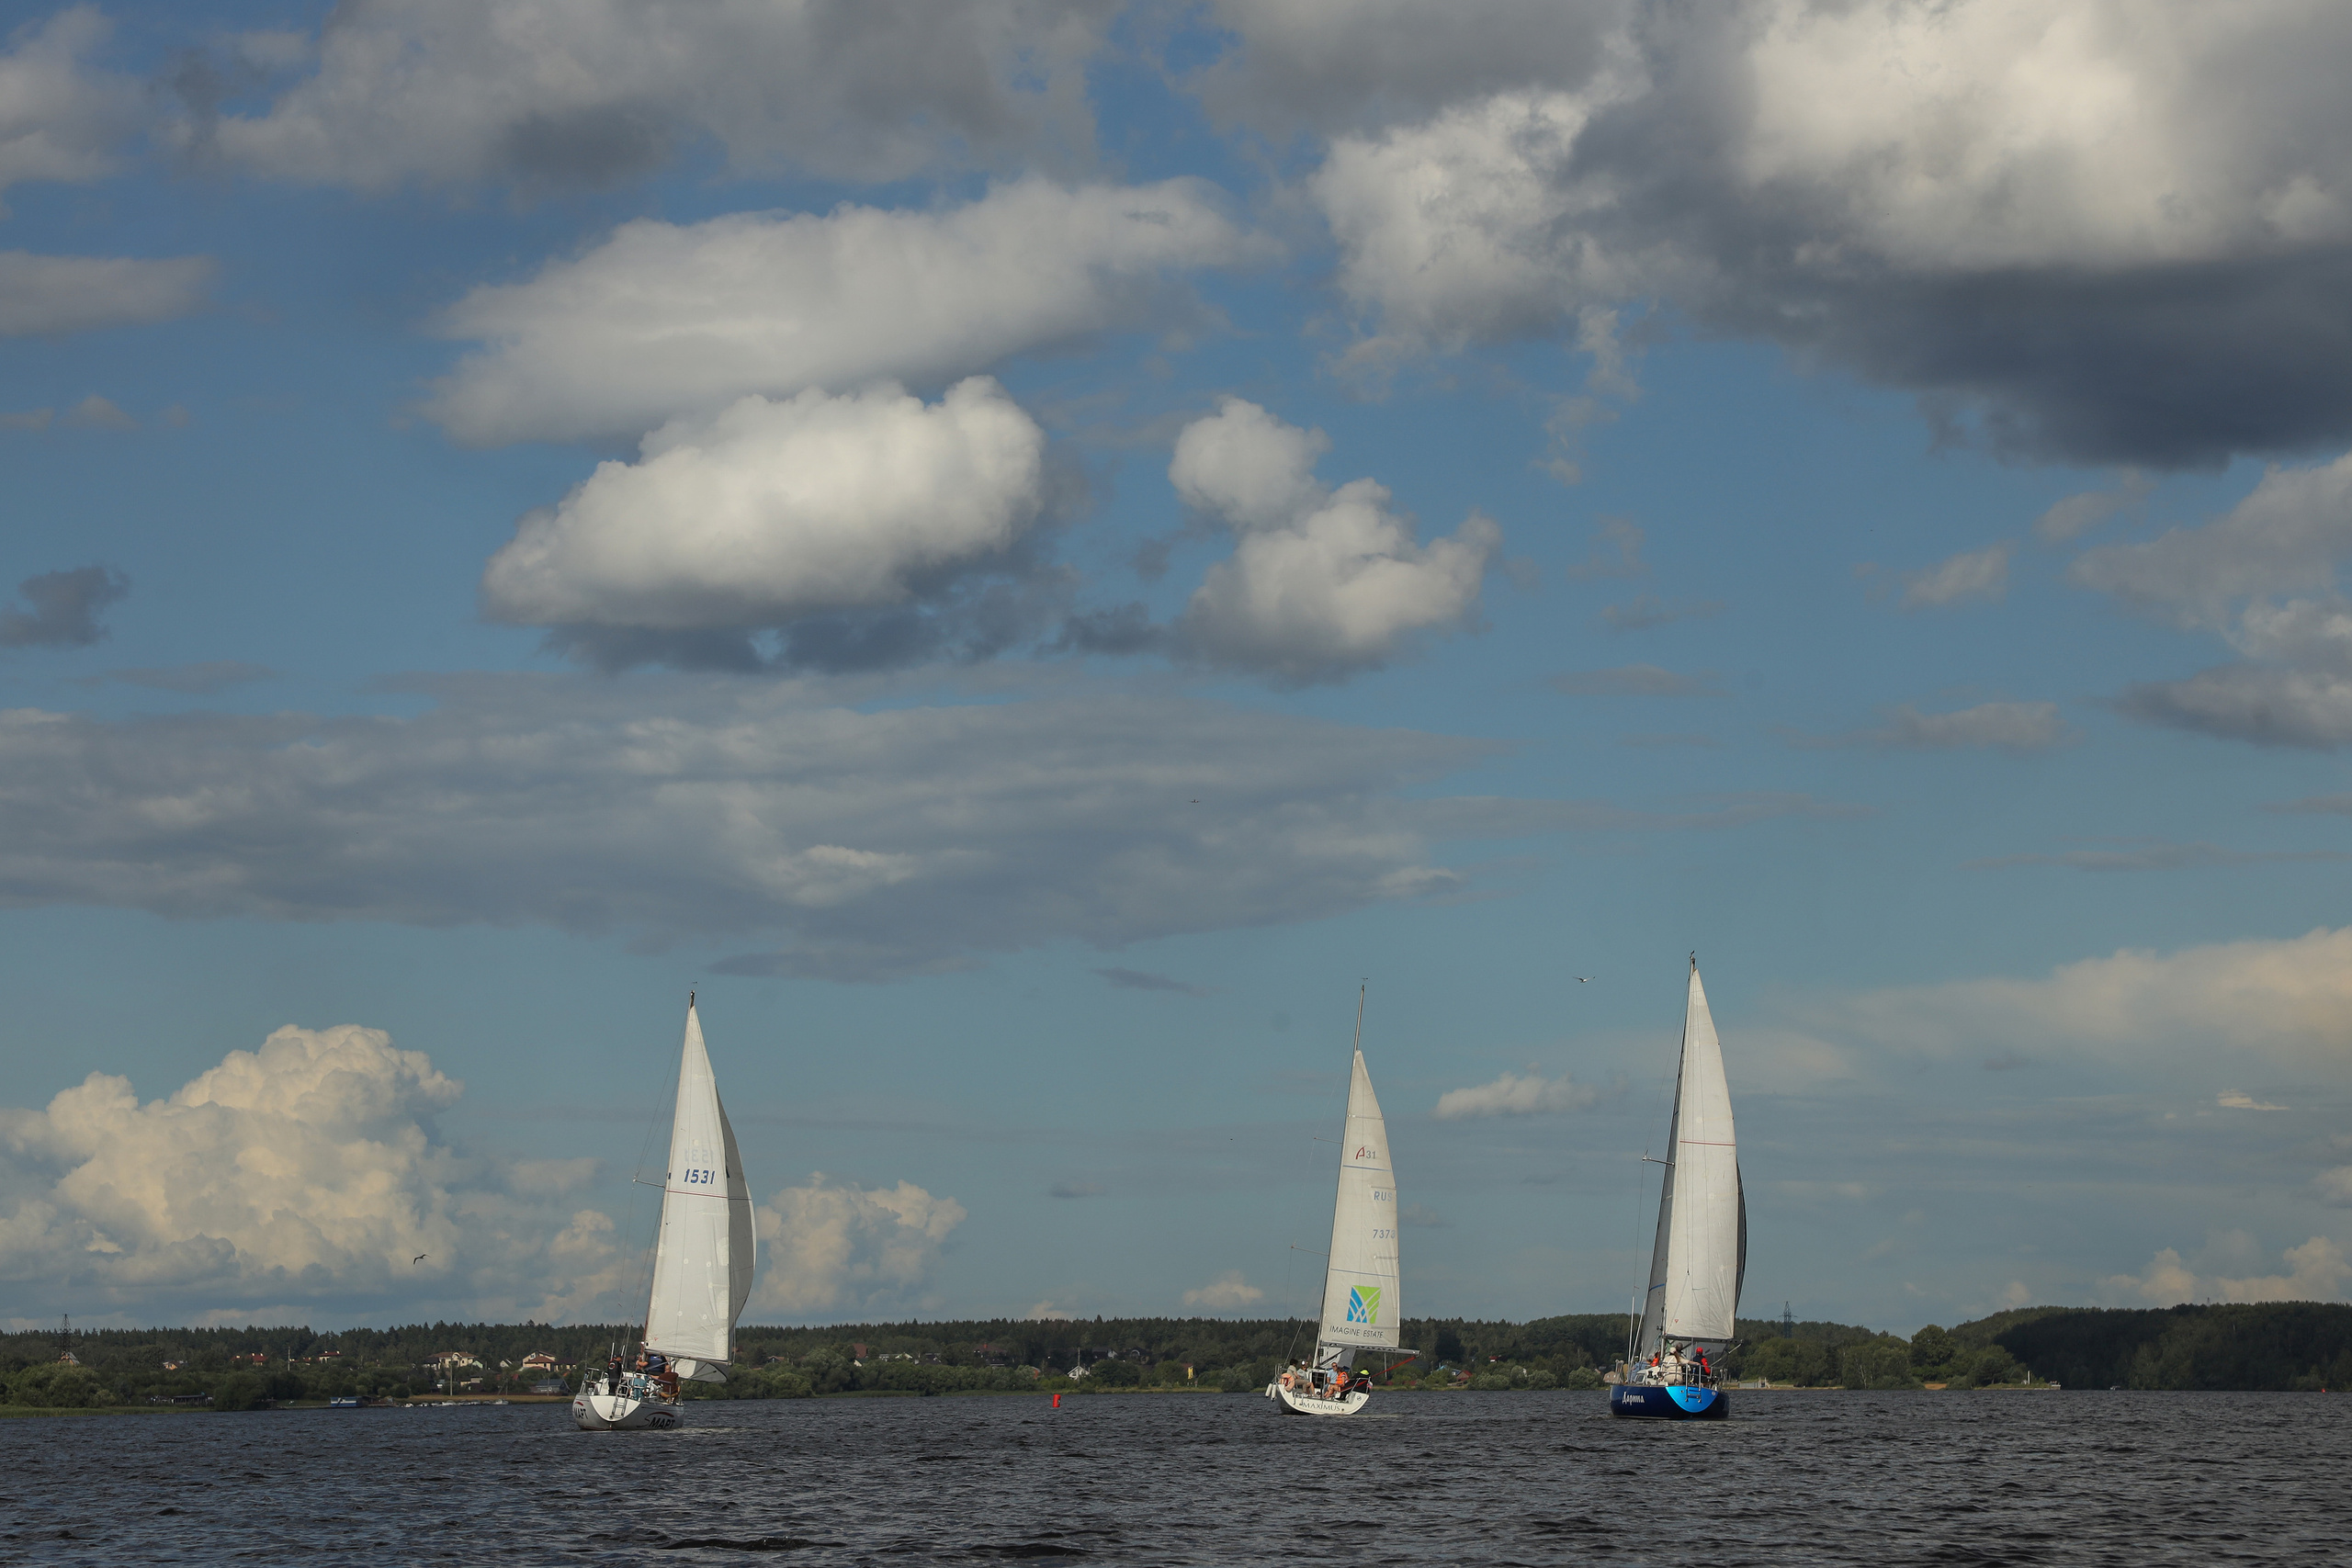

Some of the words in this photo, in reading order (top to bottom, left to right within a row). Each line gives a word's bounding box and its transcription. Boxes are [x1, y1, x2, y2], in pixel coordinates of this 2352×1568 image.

[684, 1168, 715, 1185] 1531
[1374, 1191, 1393, 1201] RUS
[1329, 1325, 1360, 1337] IMAGINE
[1363, 1330, 1384, 1338] ESTATE
[1302, 1402, 1340, 1412] MAXIMUS
